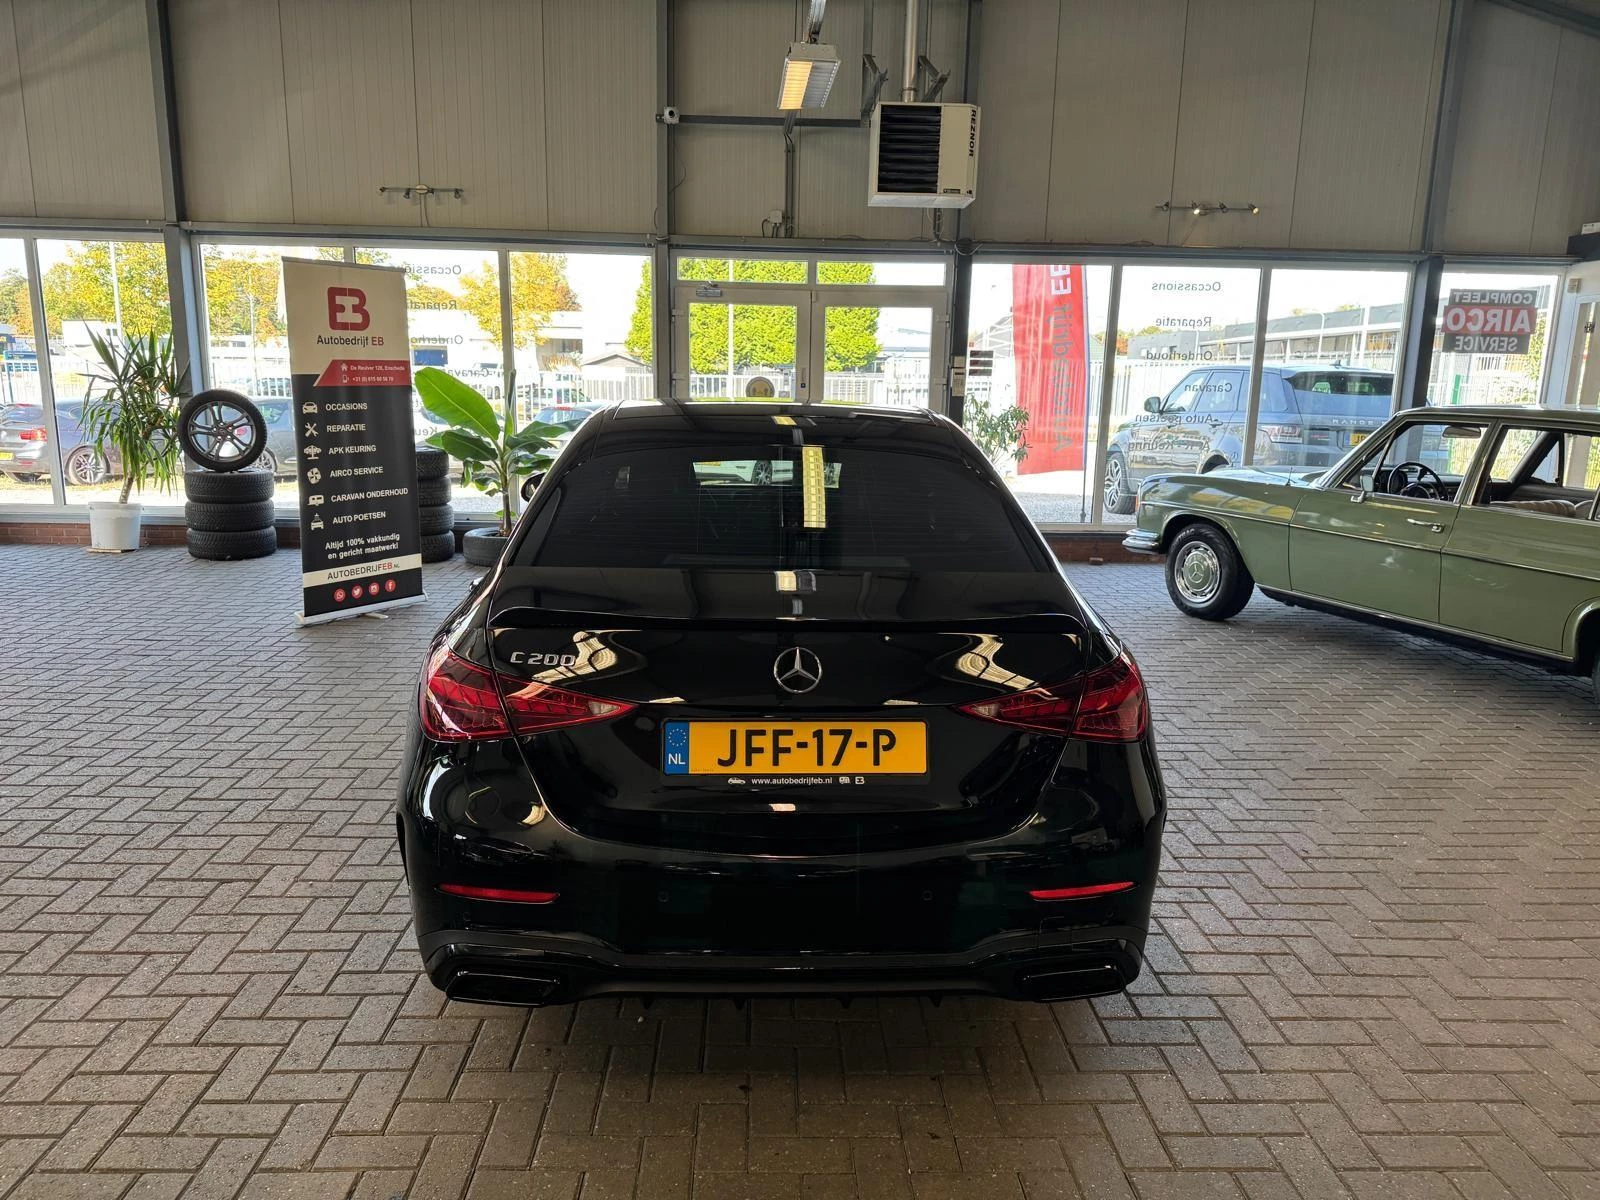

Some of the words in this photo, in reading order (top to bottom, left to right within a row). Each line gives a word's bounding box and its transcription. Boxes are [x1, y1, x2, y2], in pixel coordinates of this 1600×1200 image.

[968, 109, 977, 157] REZNOR
[316, 334, 369, 348] Autobedrijf
[371, 336, 385, 346] EB
[325, 402, 368, 411] OCCASIONS
[326, 423, 366, 433] REPARATIE
[328, 446, 344, 455] APK
[345, 444, 377, 454] KEURING
[329, 470, 352, 478] AIRCO
[353, 466, 384, 476] SERVICE
[330, 492, 365, 502] CARAVAN
[366, 487, 409, 499] ONDERHOUD
[332, 515, 353, 525] AUTO
[353, 511, 386, 522] POETSEN
[325, 541, 344, 551] Altijd
[346, 537, 365, 547] 100%
[366, 532, 400, 543] vakkundig
[338, 549, 363, 560] gericht
[510, 651, 524, 664] C
[527, 653, 576, 667] 200
[717, 728, 897, 768] JFF-17-P
[667, 752, 686, 766] NL
[751, 776, 833, 786] www.autobedrijfeb.nl
